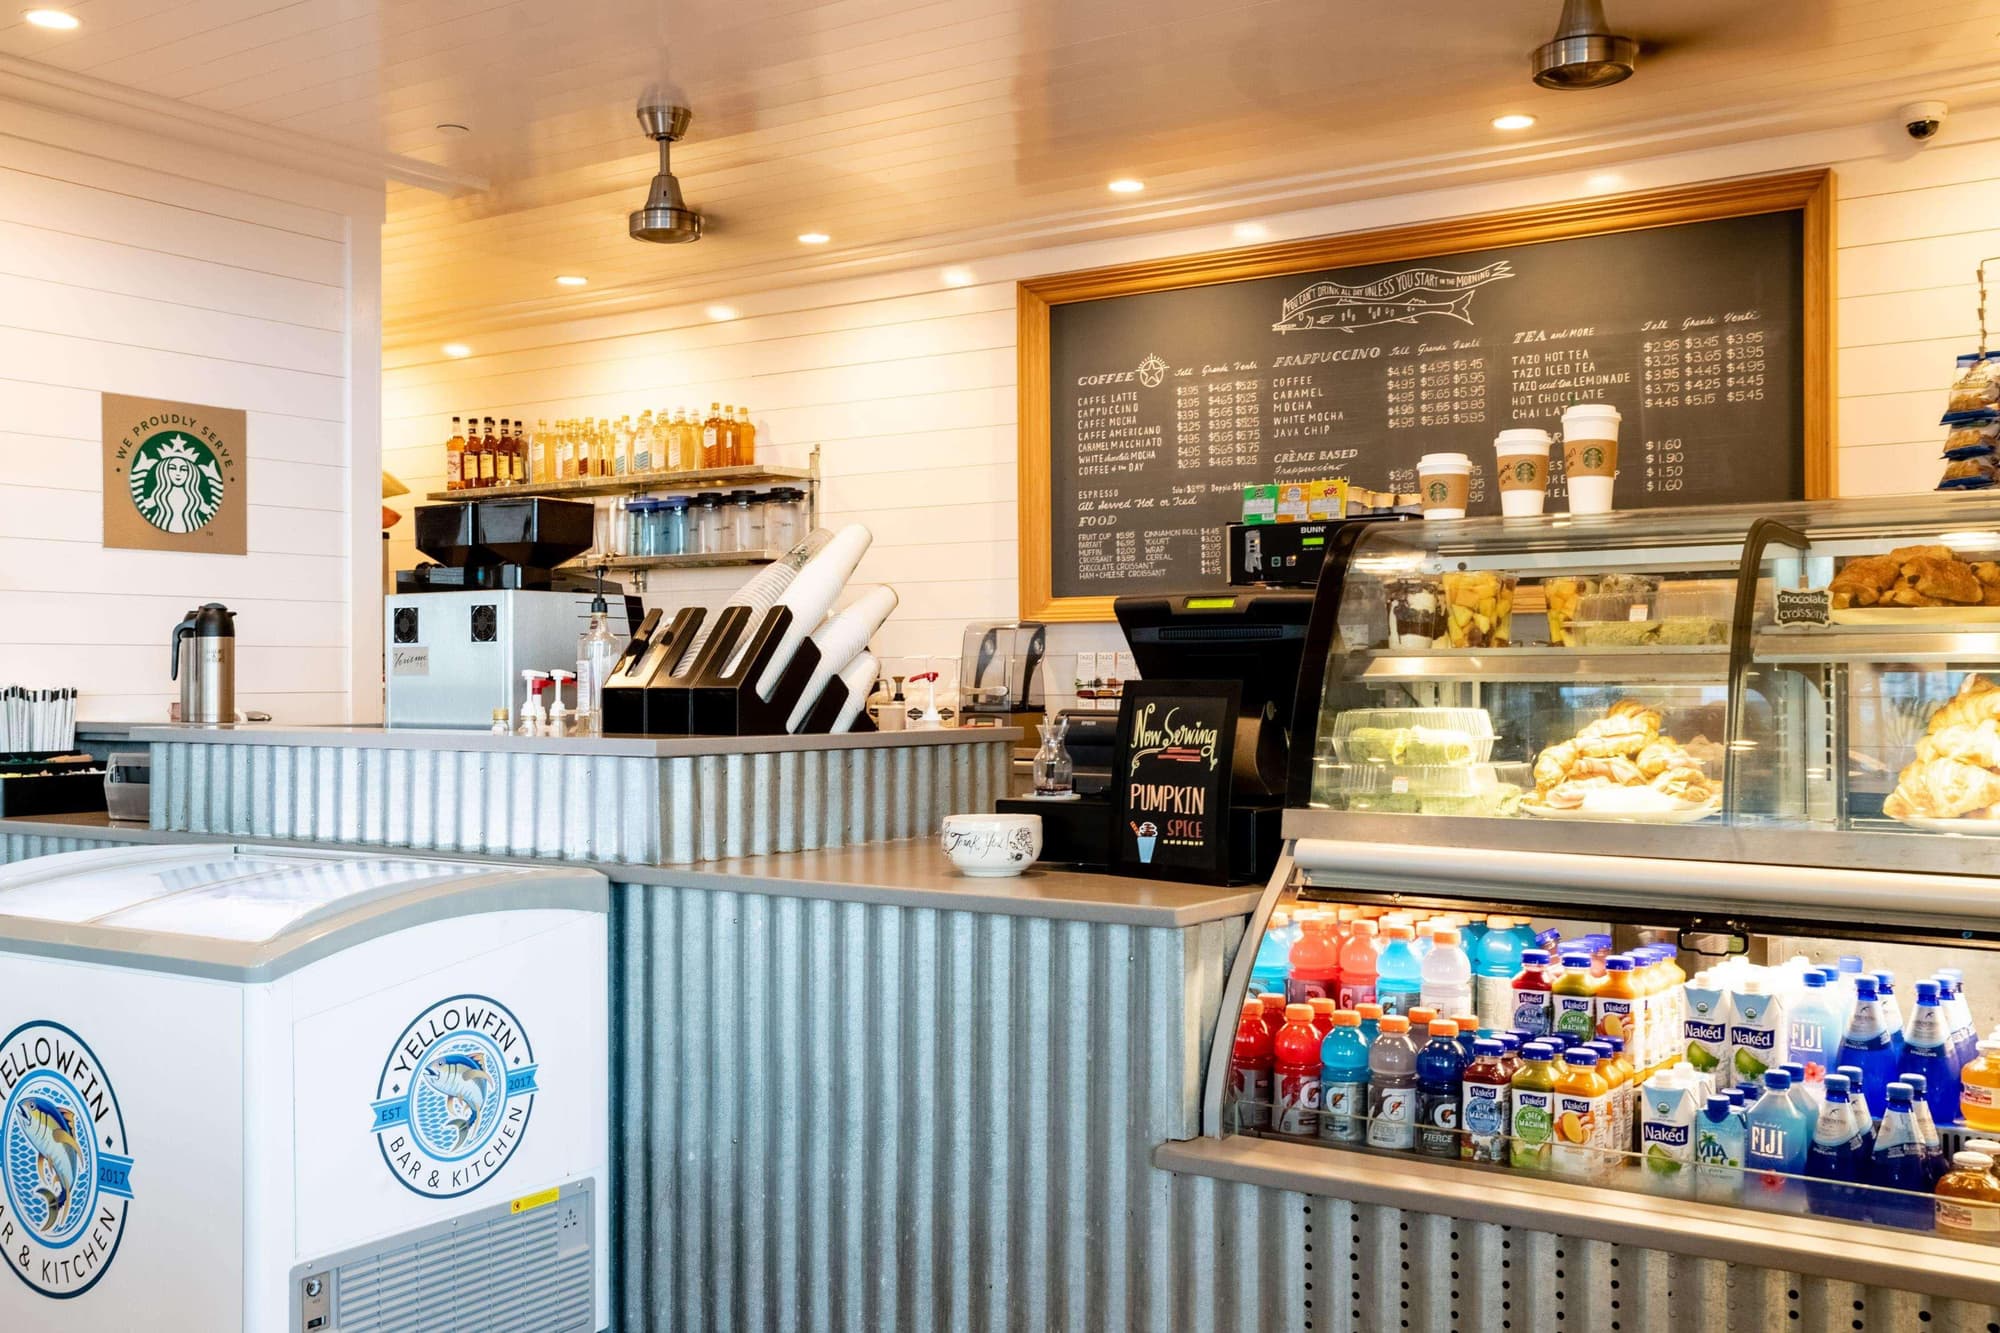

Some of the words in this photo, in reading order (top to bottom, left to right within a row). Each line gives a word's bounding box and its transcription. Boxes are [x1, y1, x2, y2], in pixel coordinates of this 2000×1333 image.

[1318, 286, 1340, 296] DRINK
[1364, 279, 1395, 296] UNLESS
[1396, 272, 1414, 292] YOU
[1414, 272, 1438, 288] START
[1456, 270, 1490, 288] MORNING
[1513, 330, 1547, 344] TEA
[1550, 330, 1568, 339] and
[1569, 328, 1595, 338] MORE
[1684, 336, 1719, 349] $3.45
[1726, 332, 1764, 344] $3.95
[1272, 347, 1380, 368] FRAPPUCCINO
[1512, 354, 1540, 365] TAZO
[1545, 351, 1564, 362] HOT
[1568, 349, 1589, 360] TEA
[1644, 354, 1680, 367] $3.25
[1684, 350, 1721, 363] $3.65
[1726, 346, 1764, 360] $3.95
[1512, 368, 1541, 379] TAZO
[1546, 364, 1570, 376] ICED
[1574, 362, 1596, 373] TEA
[1644, 368, 1680, 380] $3.95
[1726, 360, 1766, 373] $4.95
[1078, 372, 1136, 386] COFFEE
[1273, 376, 1312, 388] COFFEE
[1512, 380, 1537, 392] TAZO
[1574, 372, 1630, 387] LEMONADE
[1273, 388, 1324, 400] CARAMEL
[1644, 382, 1680, 394] $3.75
[1078, 395, 1106, 407] CAFFE
[1112, 392, 1138, 403] LATTE
[1512, 396, 1532, 406] HOT
[1684, 393, 1716, 406] $5.15
[1726, 388, 1764, 402] $5.45
[1078, 402, 1139, 418] CAPPUCCINO
[1274, 401, 1312, 412] MOCHA
[1078, 418, 1105, 430] CAFFE
[1109, 416, 1136, 426] MOCHA
[1274, 414, 1306, 425] WHITE
[1308, 412, 1344, 422] MOCHA
[1512, 410, 1540, 420] CHAI
[1078, 430, 1106, 441] CAFFE
[1109, 425, 1160, 438] AMERICANO
[1273, 427, 1299, 438] JAVA
[1304, 425, 1330, 436] CHIP
[116, 438, 133, 460] WE
[132, 414, 197, 437] PROUDLY
[201, 426, 234, 468] SERVE
[1078, 442, 1109, 452] CARAMEL
[1111, 437, 1162, 450] MACCHIATO
[1078, 454, 1104, 464] WHITE
[1130, 450, 1156, 460] MOCHA
[1274, 450, 1316, 463] CRÈME
[1319, 449, 1358, 460] BASED
[1078, 464, 1109, 476] COFFEE
[1128, 462, 1144, 472] DAY
[1078, 490, 1118, 500] ESPRESSO
[1078, 502, 1094, 512] All
[1098, 500, 1131, 510] Served
[1134, 498, 1154, 508] Hot
[1172, 496, 1197, 506] Iced
[1078, 515, 1117, 528] FOOD
[1300, 526, 1325, 534] BUNN
[1780, 595, 1829, 604] chocolate
[1130, 703, 1162, 748] Now
[1130, 784, 1206, 815] PUMPKIN
[1168, 819, 1204, 838] SPICE
[394, 1006, 516, 1072] YELLOWFIN
[1791, 1024, 1822, 1050] FIJI
[509, 1076, 531, 1090] 2017
[1300, 1081, 1320, 1108] G
[1326, 1087, 1349, 1114] G
[382, 1108, 400, 1122] EST
[1383, 1094, 1407, 1121] G
[1434, 1104, 1456, 1128] G
[1470, 1112, 1498, 1120] MACHINE
[1520, 1120, 1548, 1130] MACHINE
[1424, 1133, 1454, 1142] FIERCE
[1752, 1126, 1784, 1154] FIJI
[390, 1136, 422, 1180] BAR
[428, 1170, 440, 1188] &
[452, 1107, 523, 1188] KITCHEN
[1698, 1140, 1728, 1159] VITA
[100, 1168, 126, 1185] 2017
[19, 1245, 30, 1271] &
[42, 1206, 116, 1284] KITCHEN
